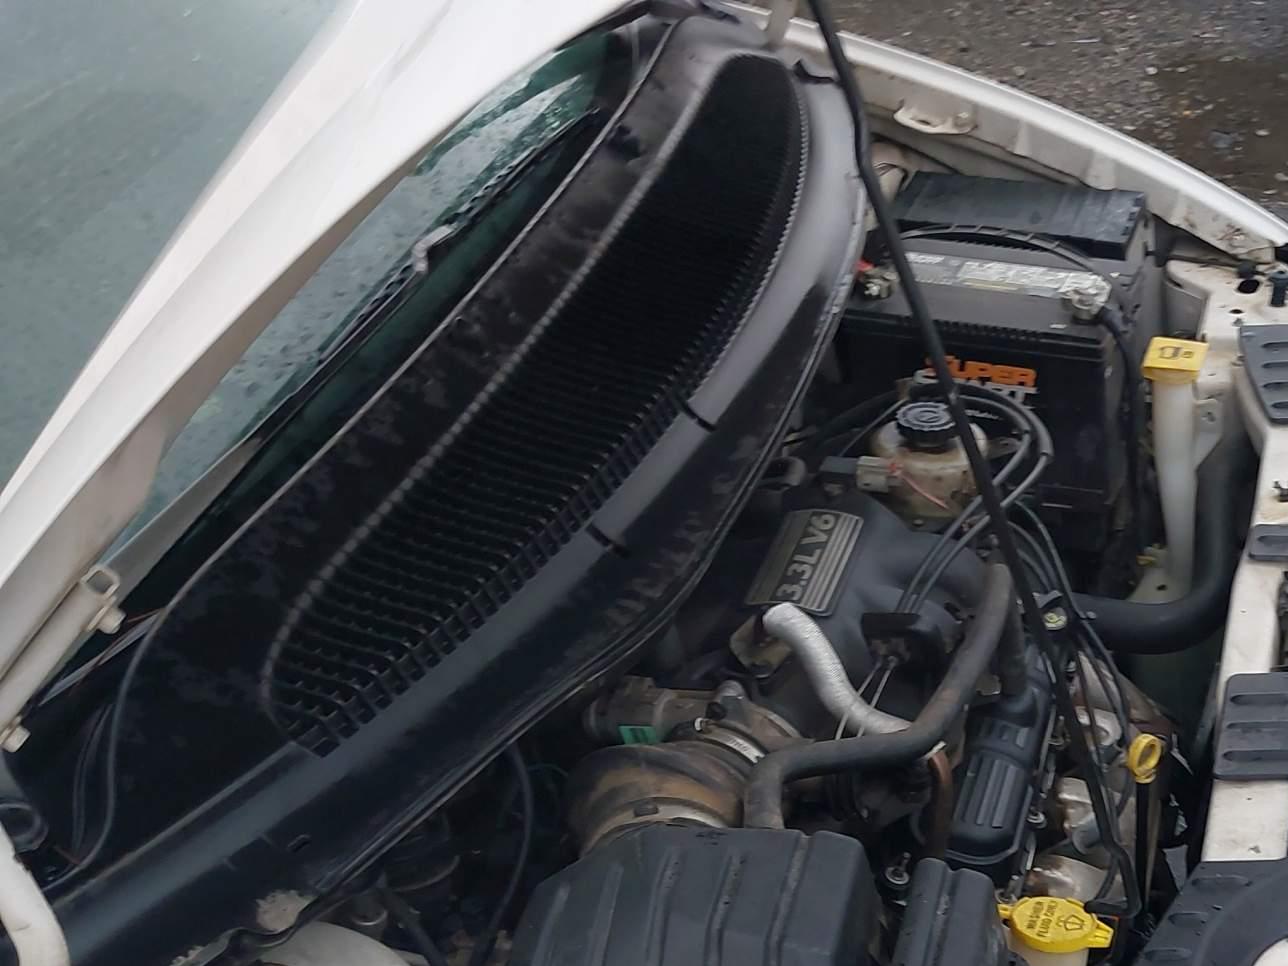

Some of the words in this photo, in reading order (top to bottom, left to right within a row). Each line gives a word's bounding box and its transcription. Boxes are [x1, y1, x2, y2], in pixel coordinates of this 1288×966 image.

[775, 542, 822, 601] 3.3L
[799, 513, 837, 545] V6
[1026, 901, 1044, 930] WASHER
[1035, 918, 1053, 938] FLUID
